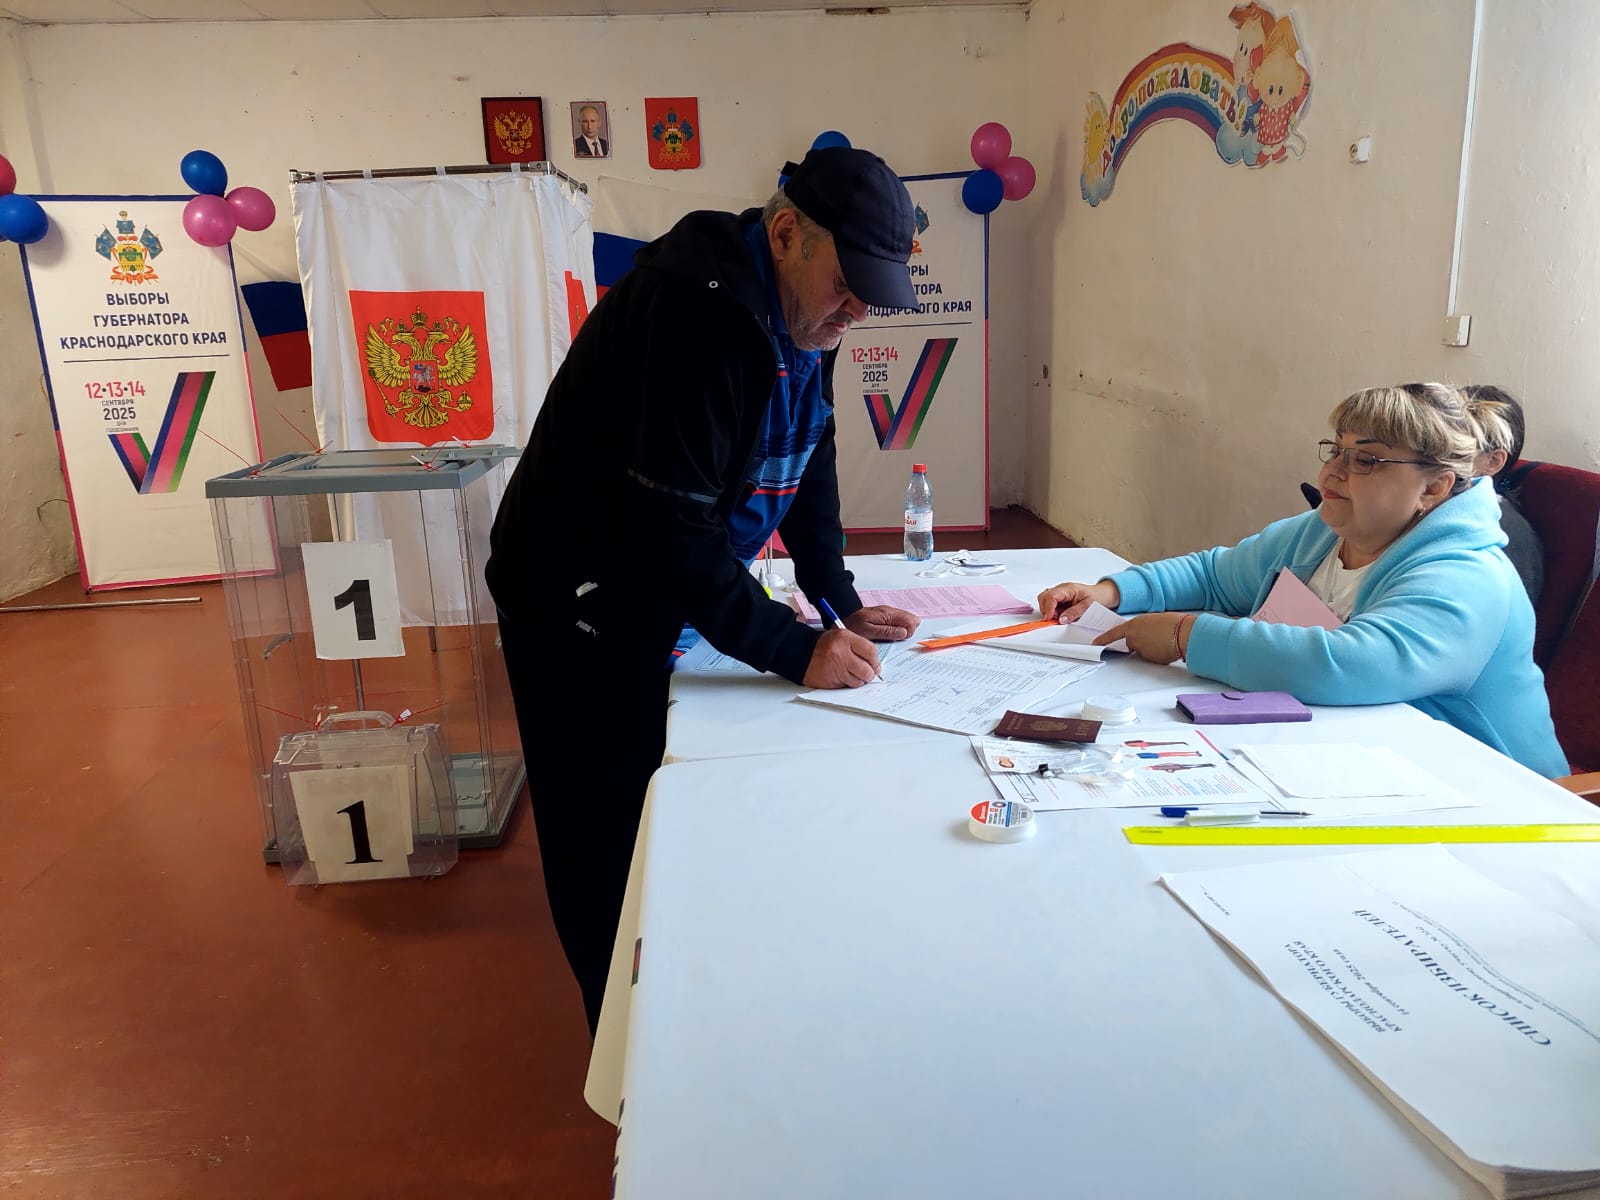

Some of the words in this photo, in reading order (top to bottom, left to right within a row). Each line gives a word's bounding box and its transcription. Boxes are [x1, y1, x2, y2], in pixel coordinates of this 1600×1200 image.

[106, 292, 170, 306] ВЫБОРЫ
[943, 301, 972, 313] КРАЯ
[93, 313, 190, 328] ГУБЕРНАТОРА
[60, 333, 189, 349] КРАСНОДАРСКОГО
[192, 331, 227, 345] КРАЯ
[862, 370, 888, 383] 2025
[103, 406, 137, 421] 2025
[333, 578, 377, 642] 1
[336, 800, 384, 866] 1
[1351, 909, 1469, 993] ИЗБИРАТЕЛЕЙ
[1464, 992, 1552, 1046] СПИСОК
